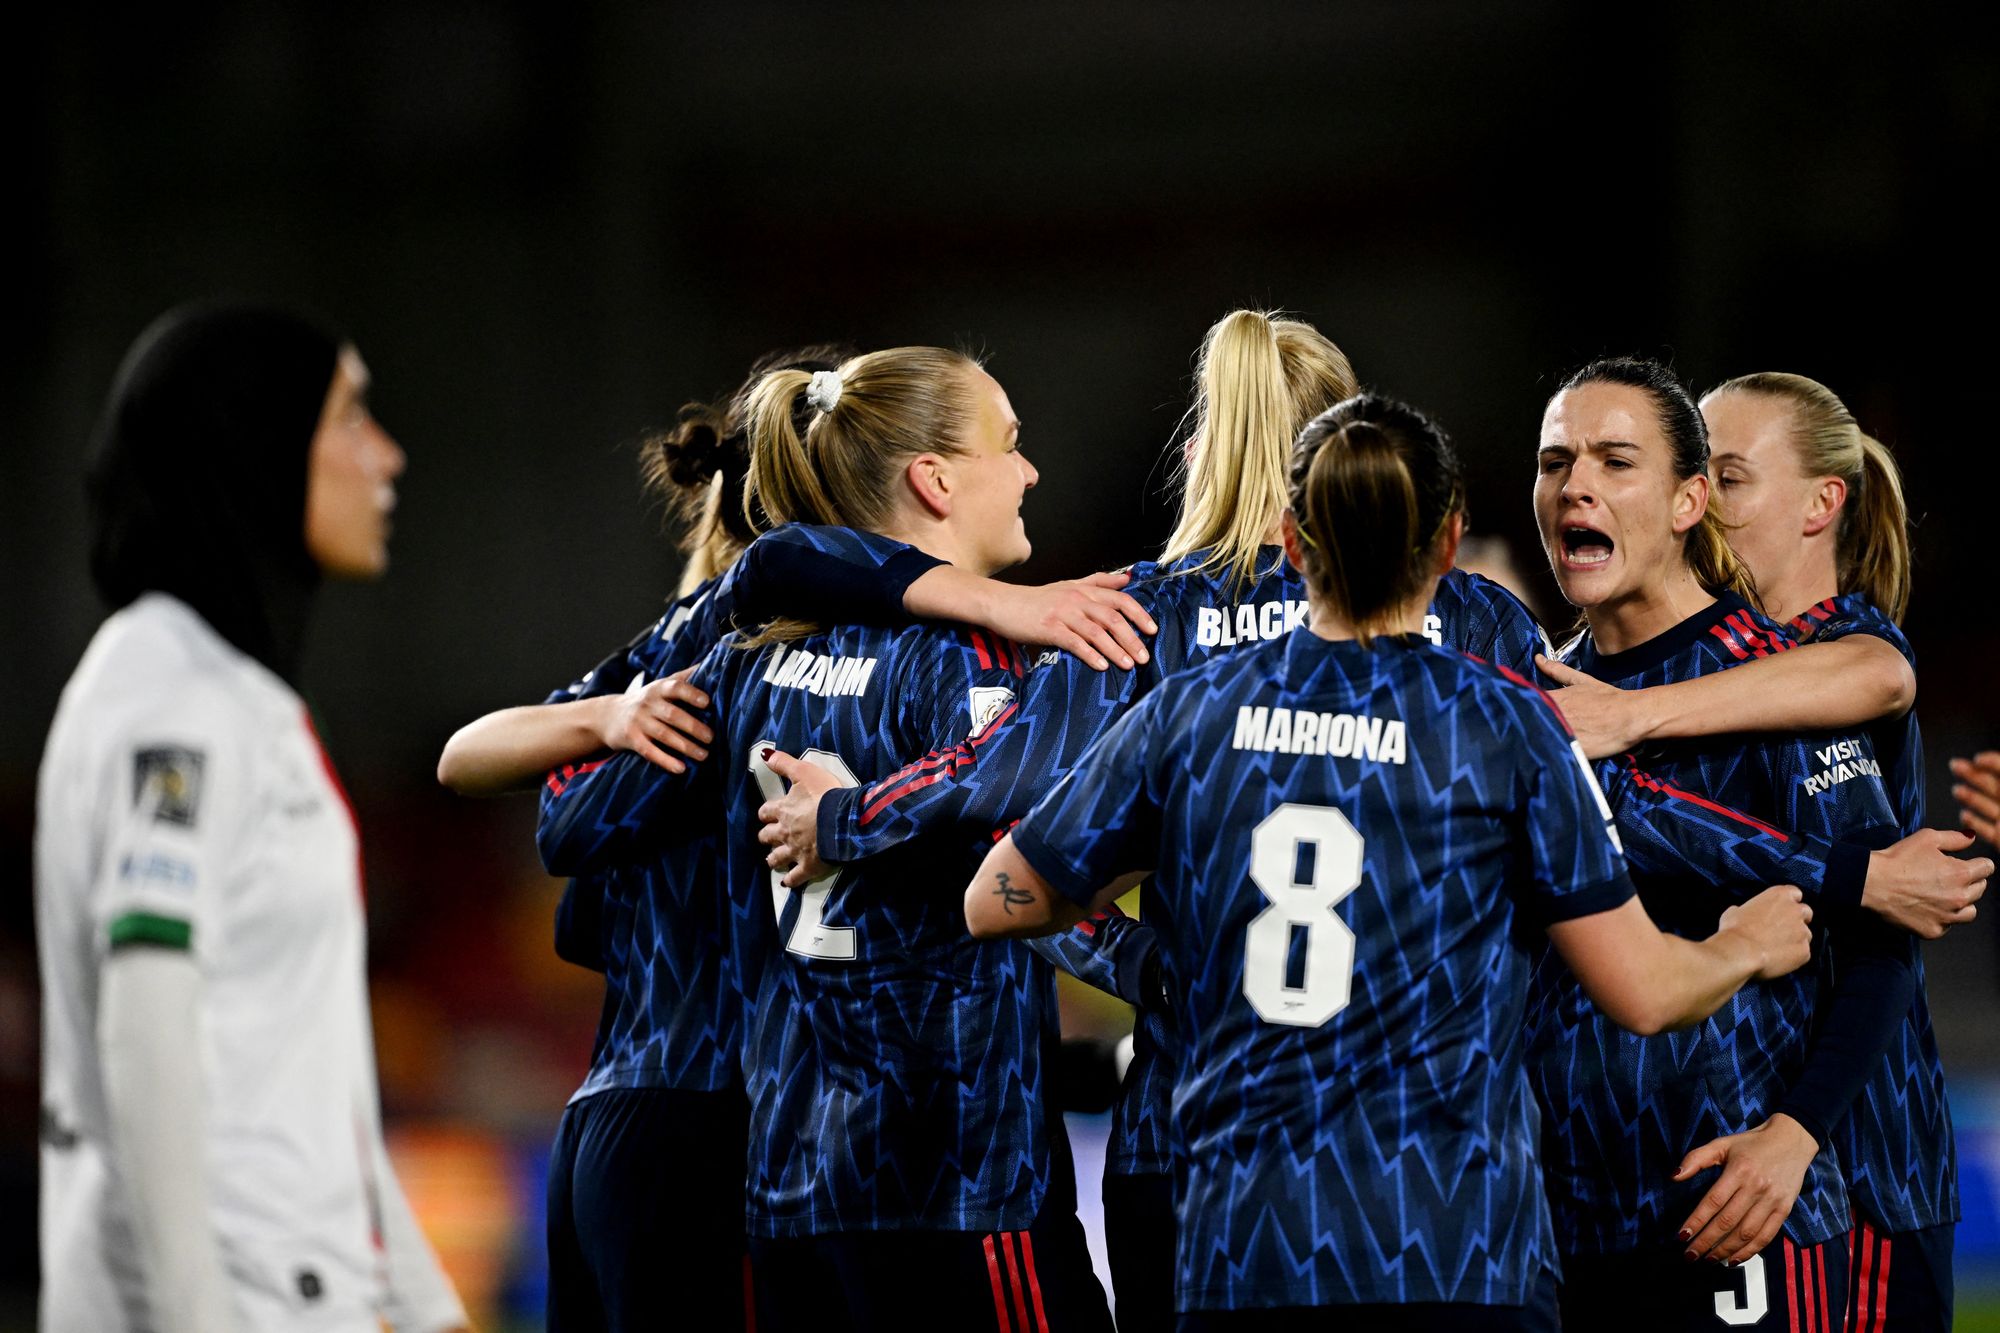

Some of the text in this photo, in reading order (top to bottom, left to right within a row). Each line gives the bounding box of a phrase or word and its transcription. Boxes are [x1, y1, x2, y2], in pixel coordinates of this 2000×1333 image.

[1197, 600, 1442, 647] BLACKS
[1232, 705, 1407, 766] MARIONA
[1815, 739, 1863, 766] VISIT
[1803, 758, 1882, 797] RWANDA
[1243, 803, 1365, 1027] 8
